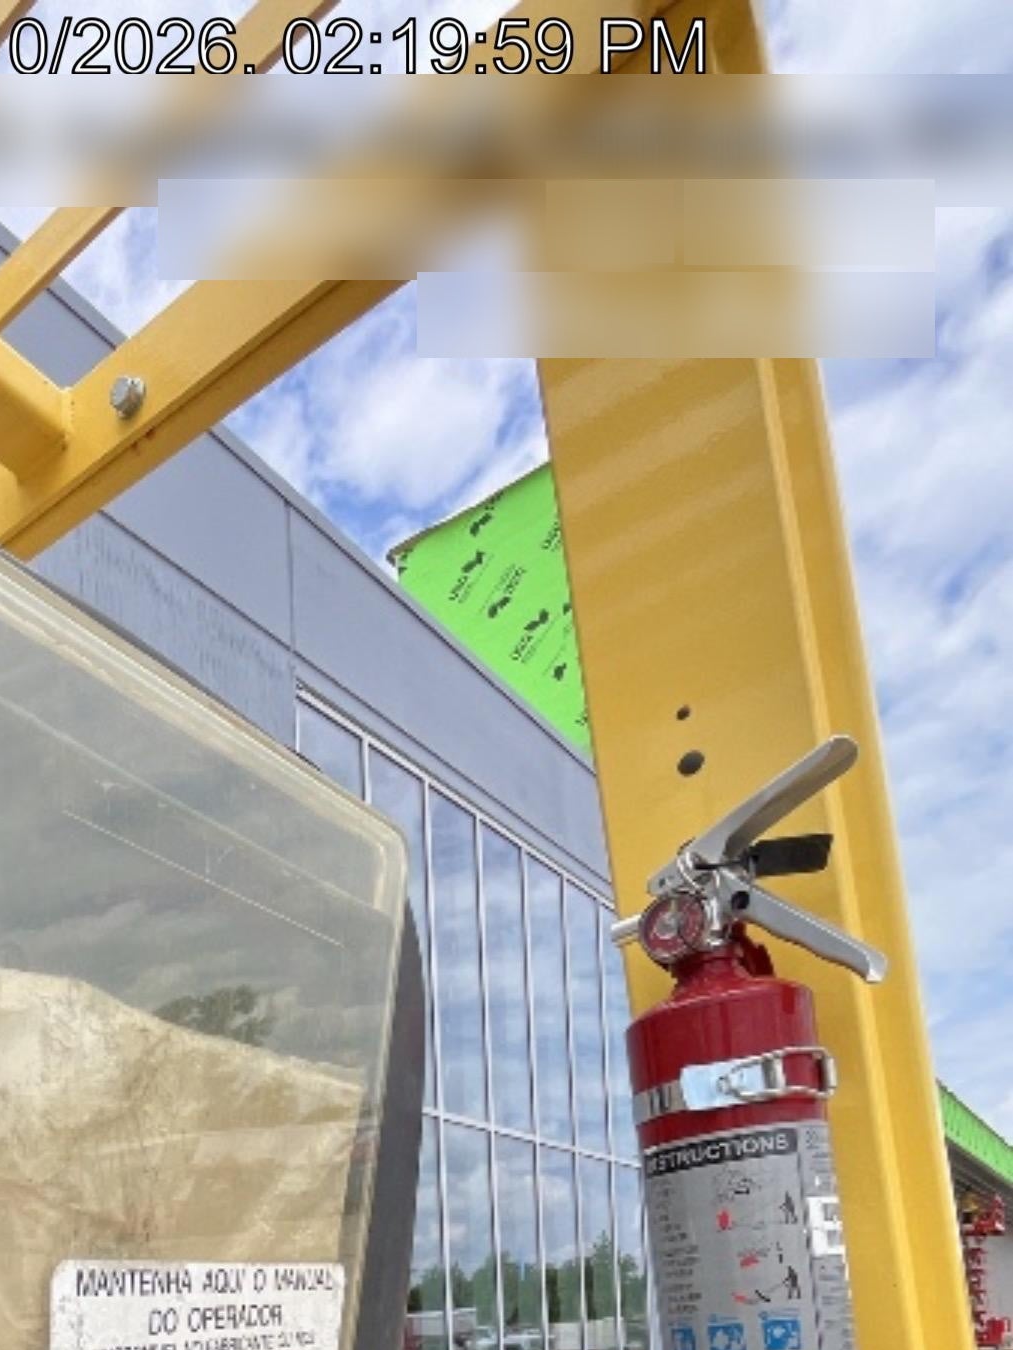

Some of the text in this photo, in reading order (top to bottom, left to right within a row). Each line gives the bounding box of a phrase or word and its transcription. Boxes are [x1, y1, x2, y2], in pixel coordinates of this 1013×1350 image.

[75, 1267, 192, 1297] MANTENHA
[253, 1267, 267, 1294] O
[148, 1303, 283, 1336] DO OPERADOR
